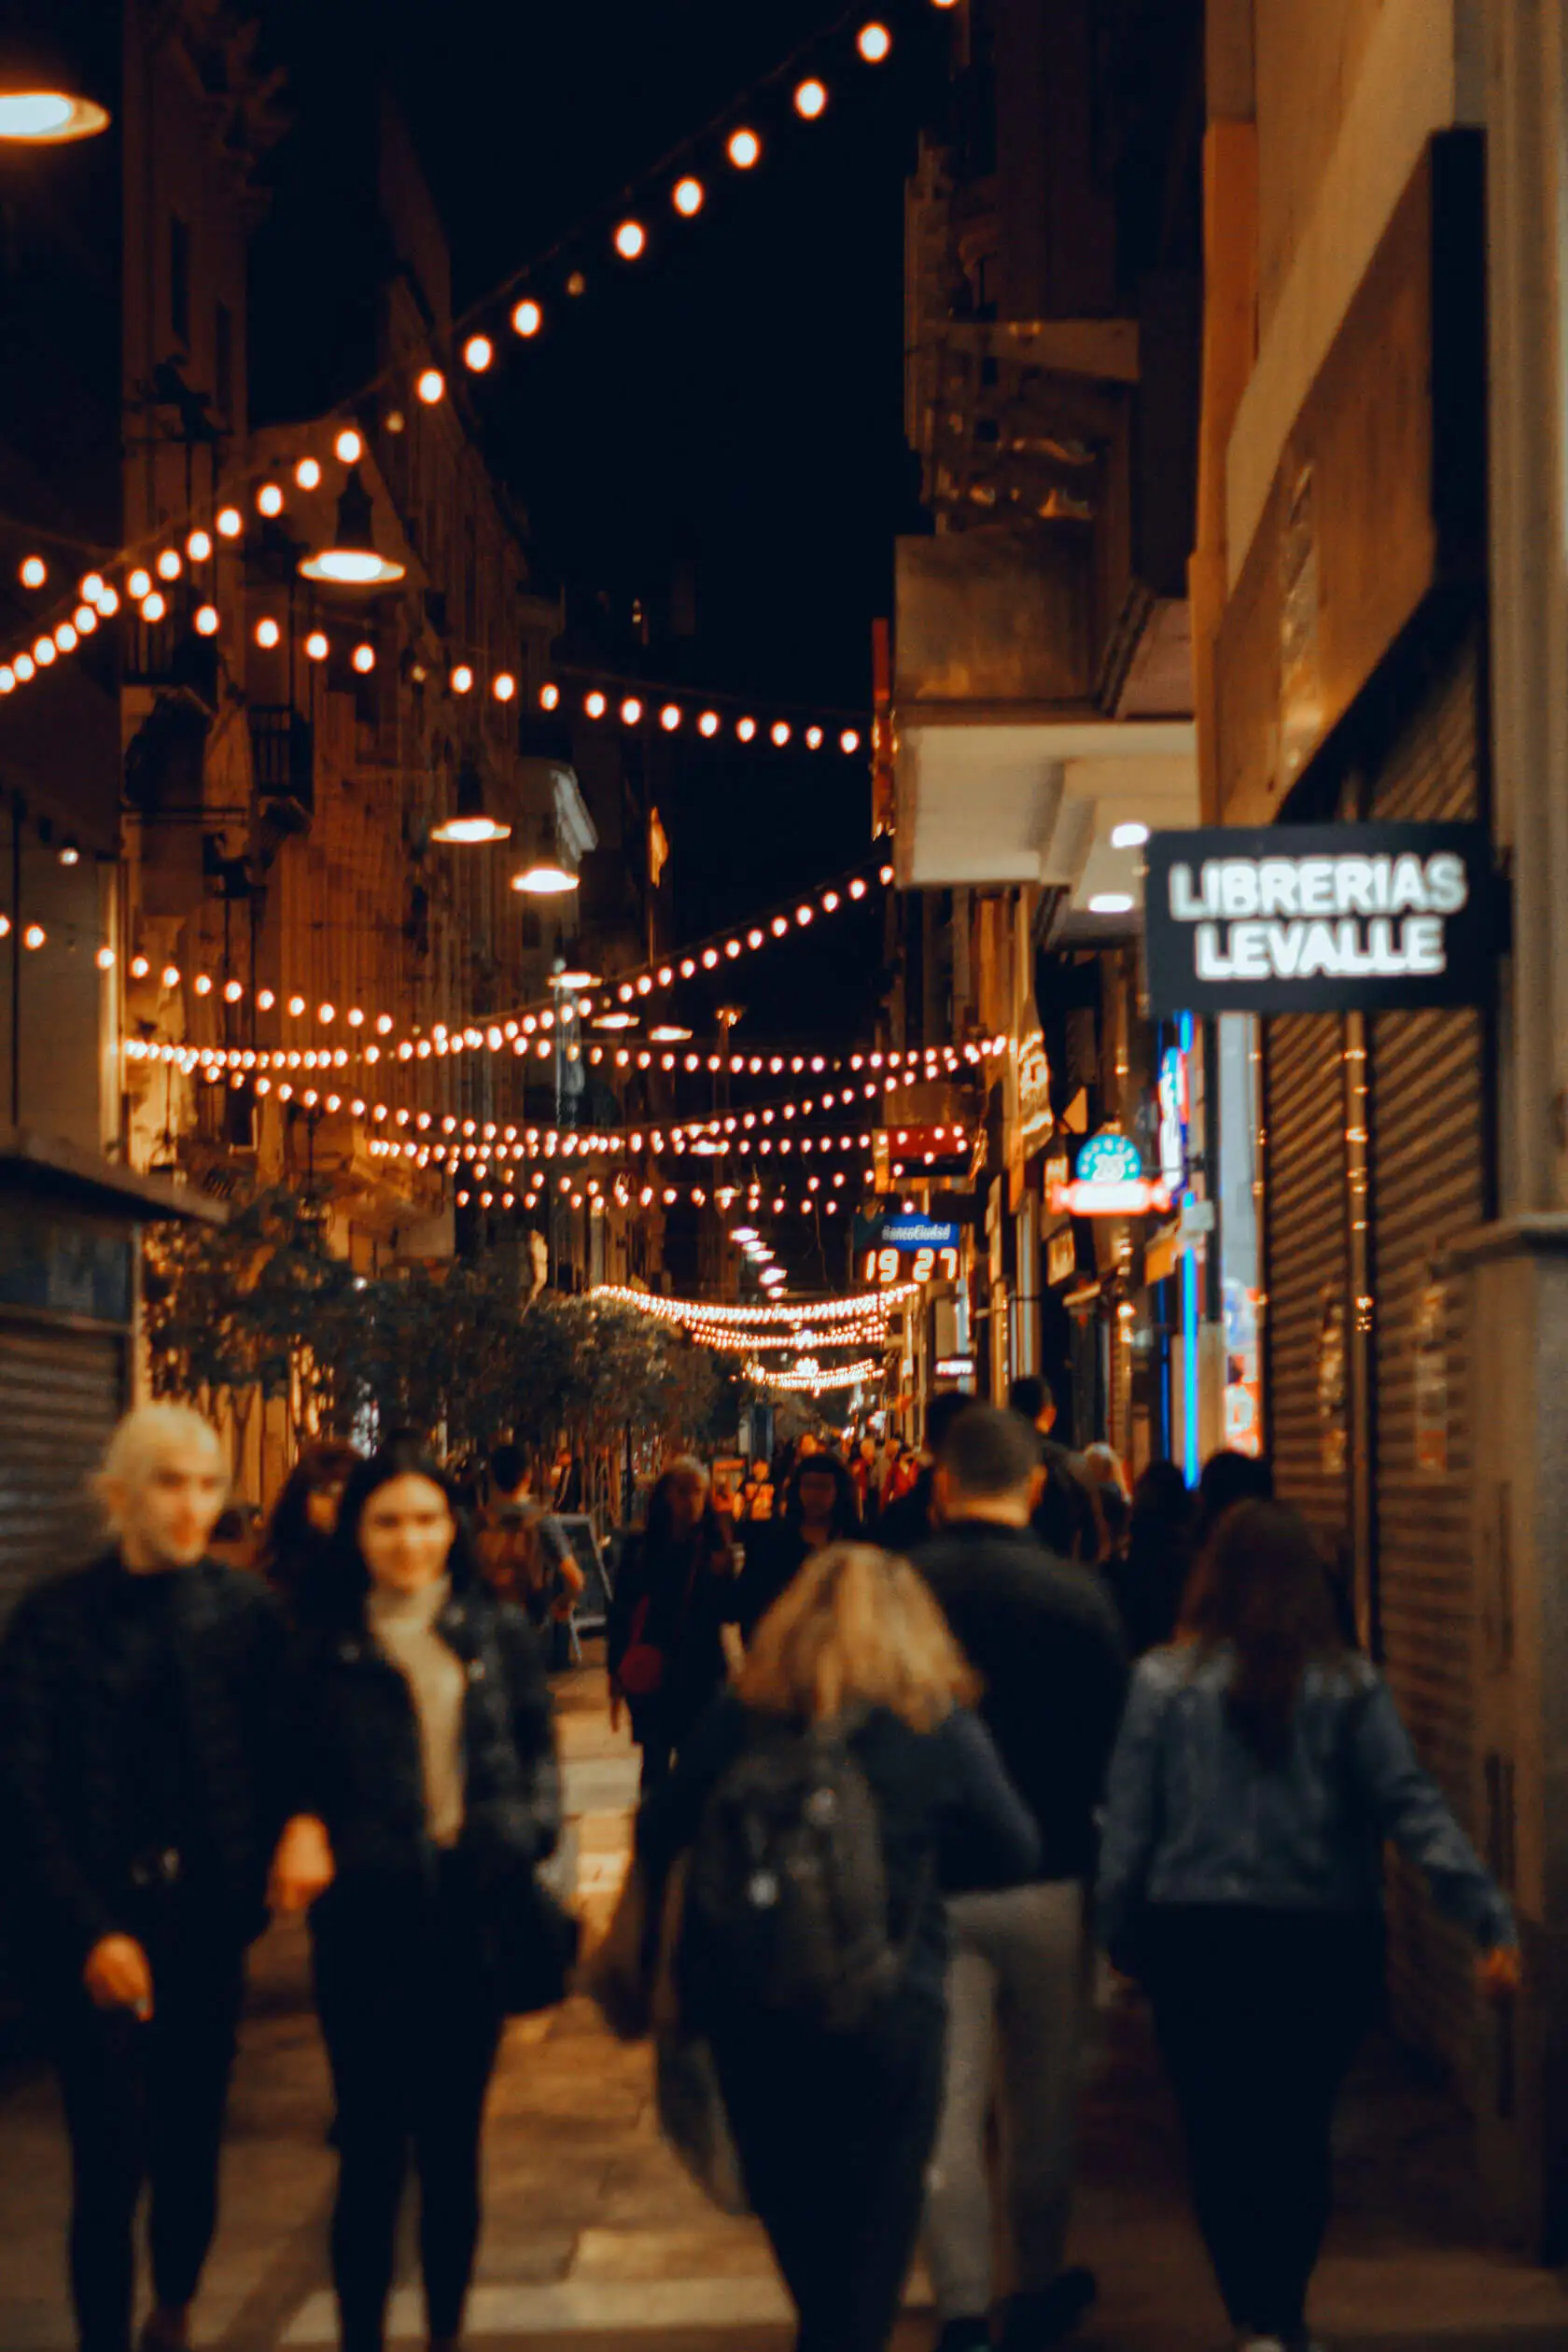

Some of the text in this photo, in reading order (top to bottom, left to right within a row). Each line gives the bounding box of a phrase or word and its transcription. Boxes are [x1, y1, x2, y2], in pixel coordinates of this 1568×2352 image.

[1169, 853, 1467, 920] LIBRERIAS
[1196, 915, 1446, 980] LEVALLE
[866, 1247, 958, 1282] 19 27
